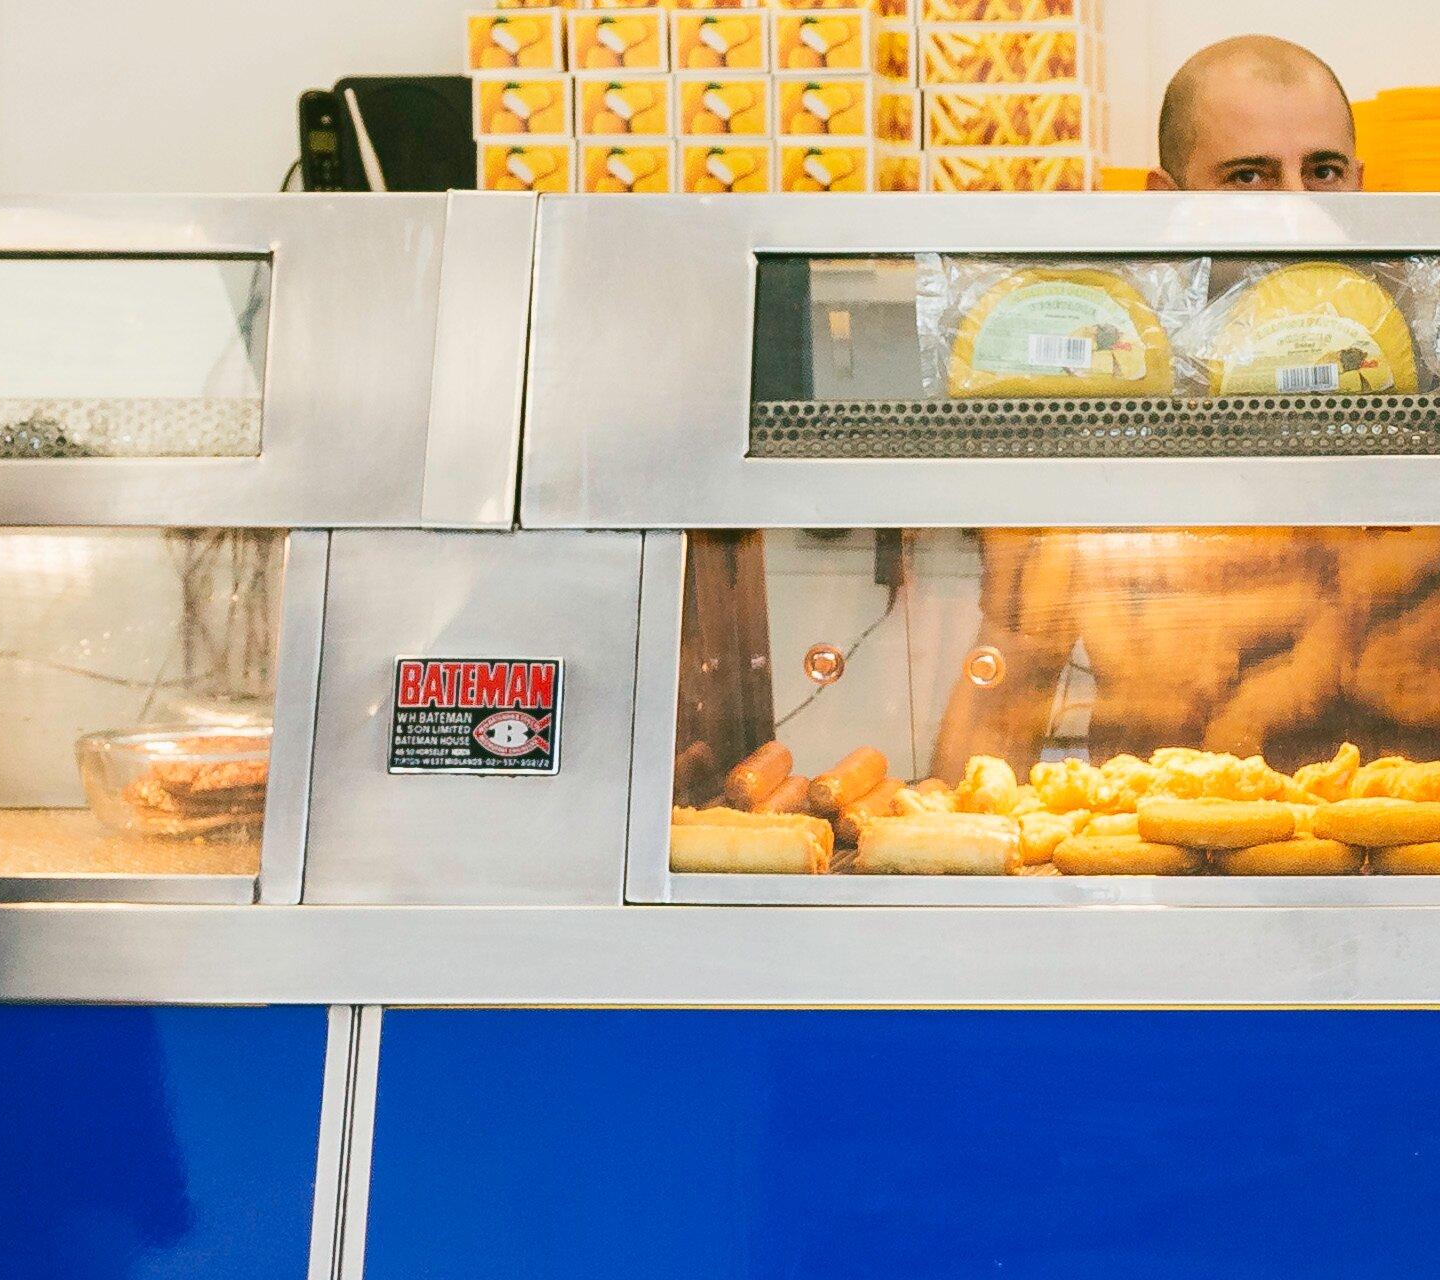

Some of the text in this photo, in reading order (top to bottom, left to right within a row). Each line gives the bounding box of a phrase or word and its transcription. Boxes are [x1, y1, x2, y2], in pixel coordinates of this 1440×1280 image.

[397, 661, 556, 710] BATEMAN
[418, 712, 473, 724] BATEMAN
[407, 725, 431, 735] SON
[432, 725, 471, 735] LIMITED
[394, 736, 471, 746] BATEMAN HOUSE
